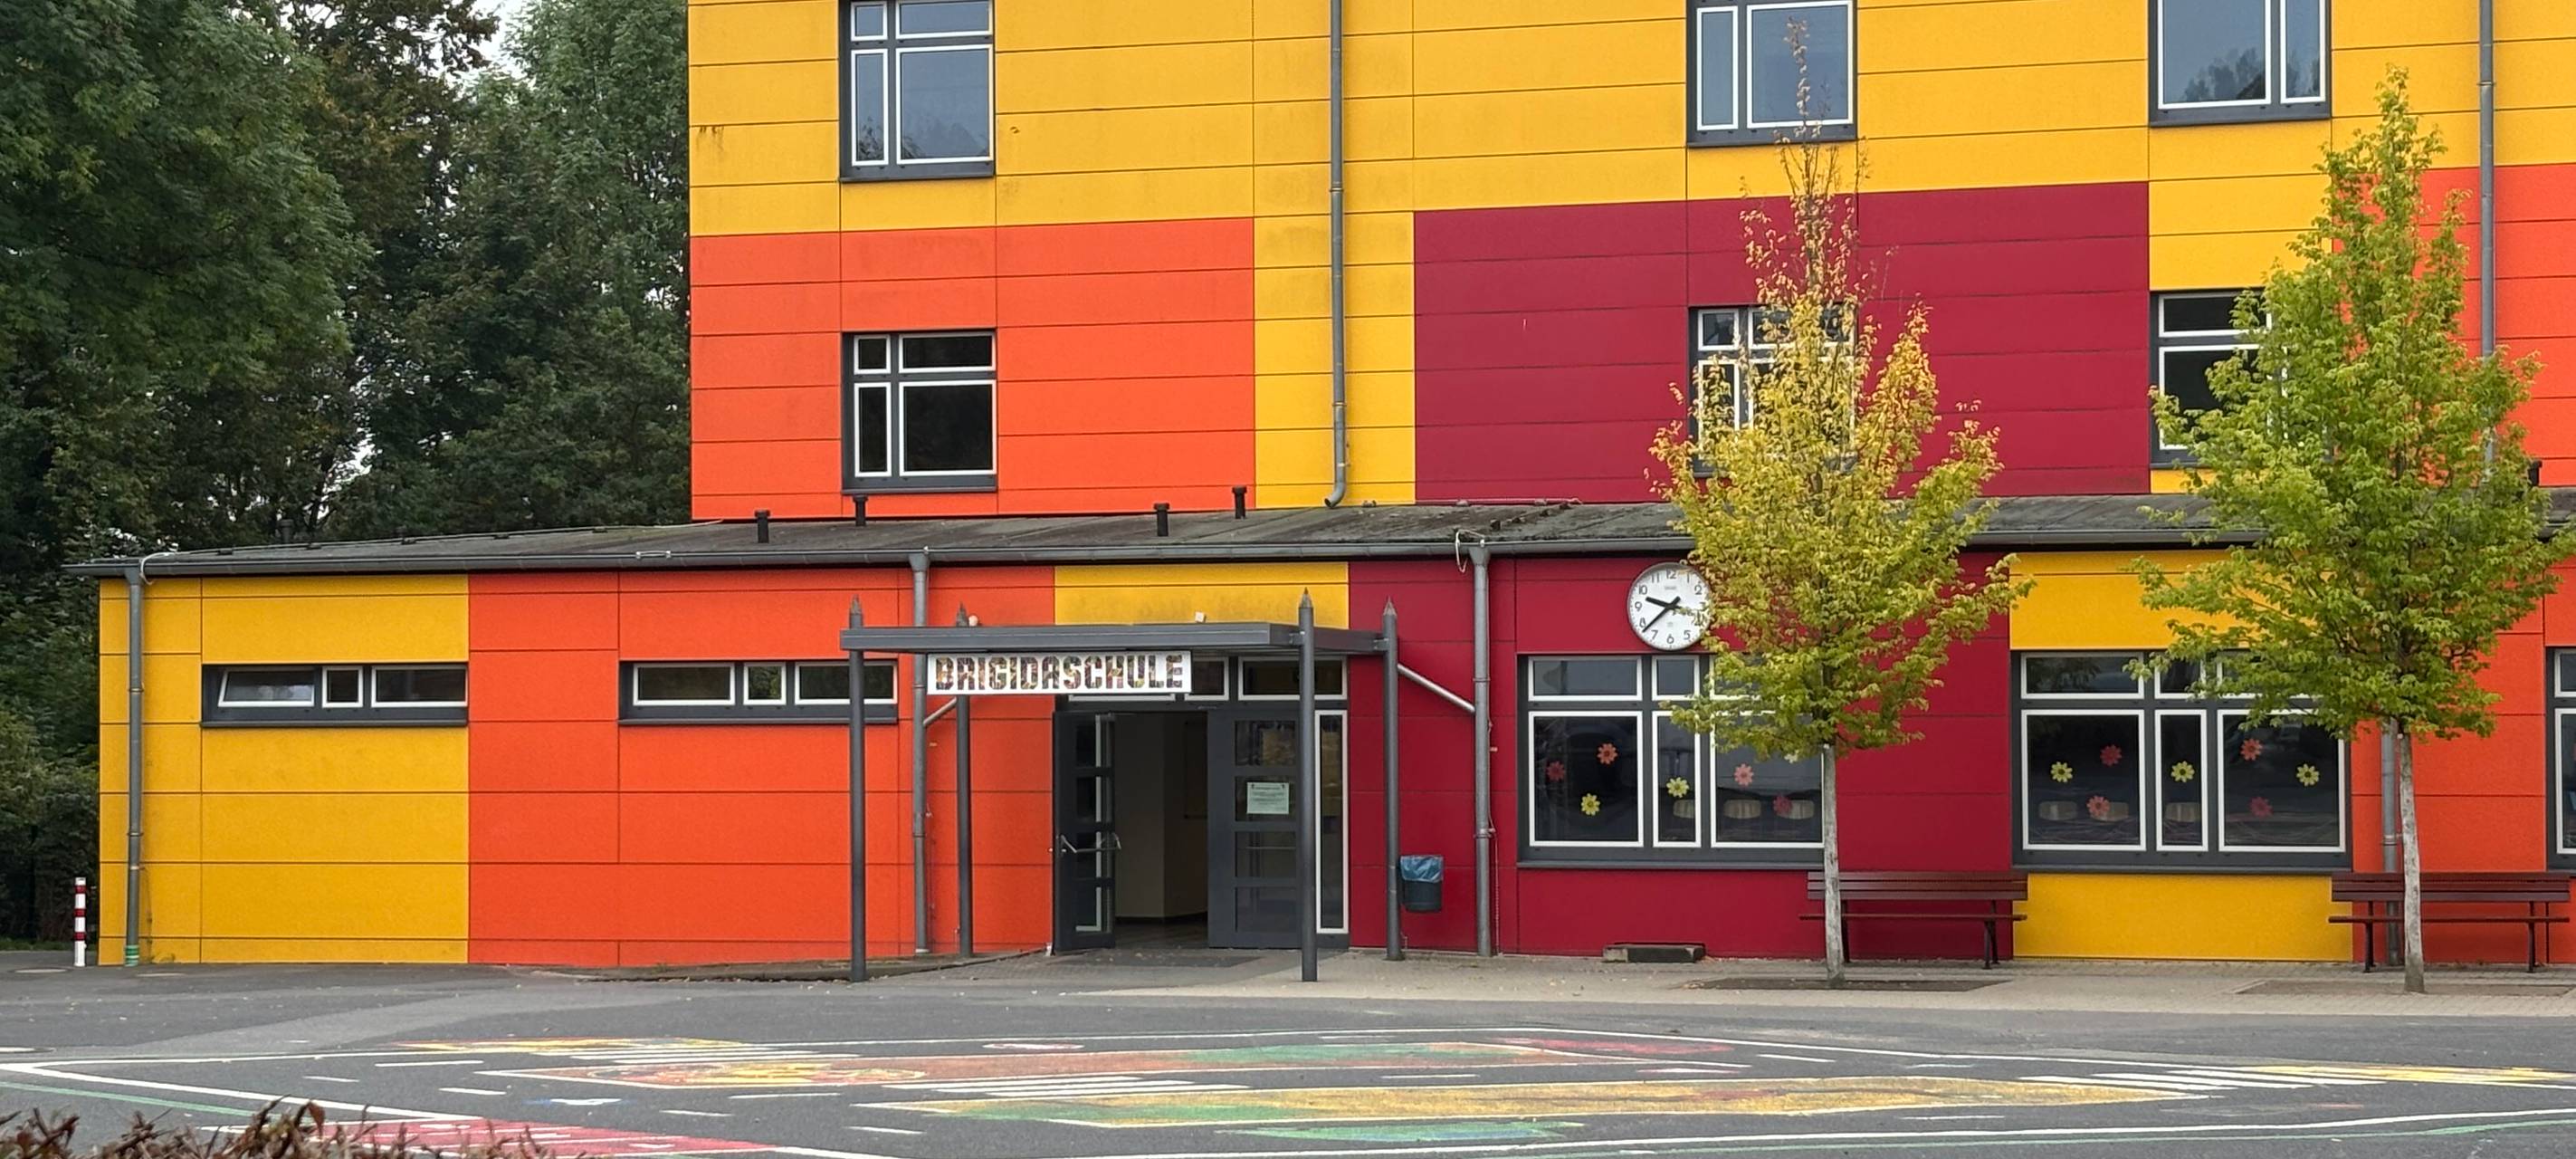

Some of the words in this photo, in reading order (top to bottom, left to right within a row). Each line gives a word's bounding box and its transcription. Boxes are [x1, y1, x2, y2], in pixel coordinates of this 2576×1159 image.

[1651, 573, 1660, 583] 11
[1666, 570, 1677, 580] 12
[1638, 585, 1647, 595] 10
[1694, 584, 1703, 595] 2
[1634, 601, 1643, 611] 9
[1639, 618, 1646, 627] 8
[1651, 629, 1658, 639] 7
[1666, 634, 1674, 644] 6
[1684, 630, 1691, 640] 5
[935, 655, 1183, 690] BRIGIDASCHULE
